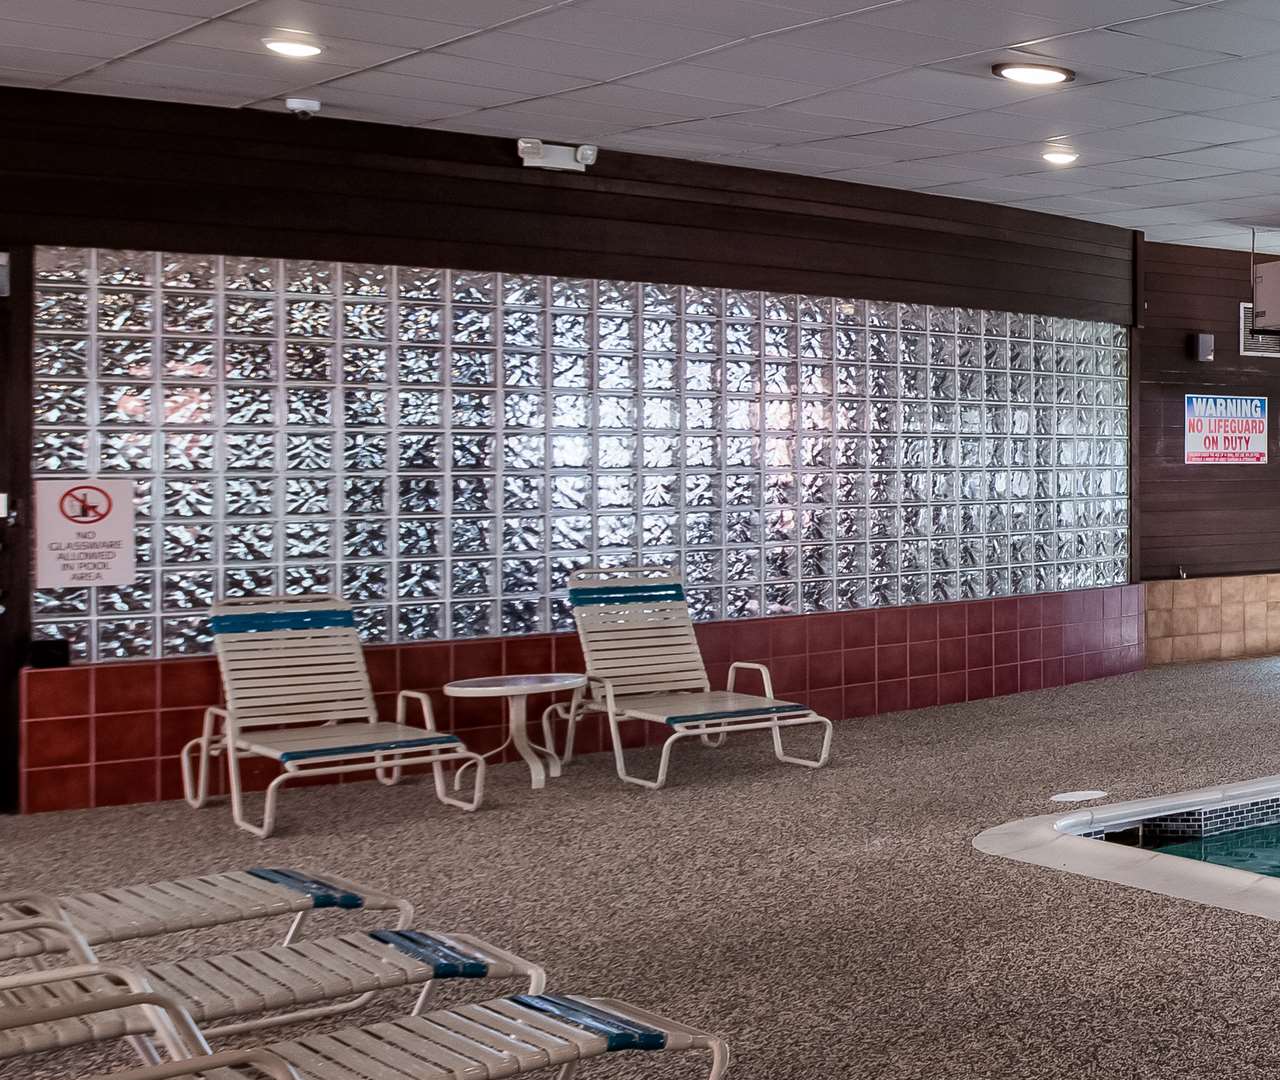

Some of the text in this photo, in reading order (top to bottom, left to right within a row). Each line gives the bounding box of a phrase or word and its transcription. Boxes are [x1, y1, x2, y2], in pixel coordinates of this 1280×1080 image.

[1193, 398, 1261, 417] WARNING
[1188, 419, 1264, 433] NO LIFEGUARD
[1204, 435, 1251, 450] ON DUTY
[75, 531, 96, 539] NO
[48, 540, 122, 550] GLASSWARE
[57, 551, 116, 561] ALLOWED
[61, 562, 111, 571] IN POOL
[70, 572, 103, 581] AREA
